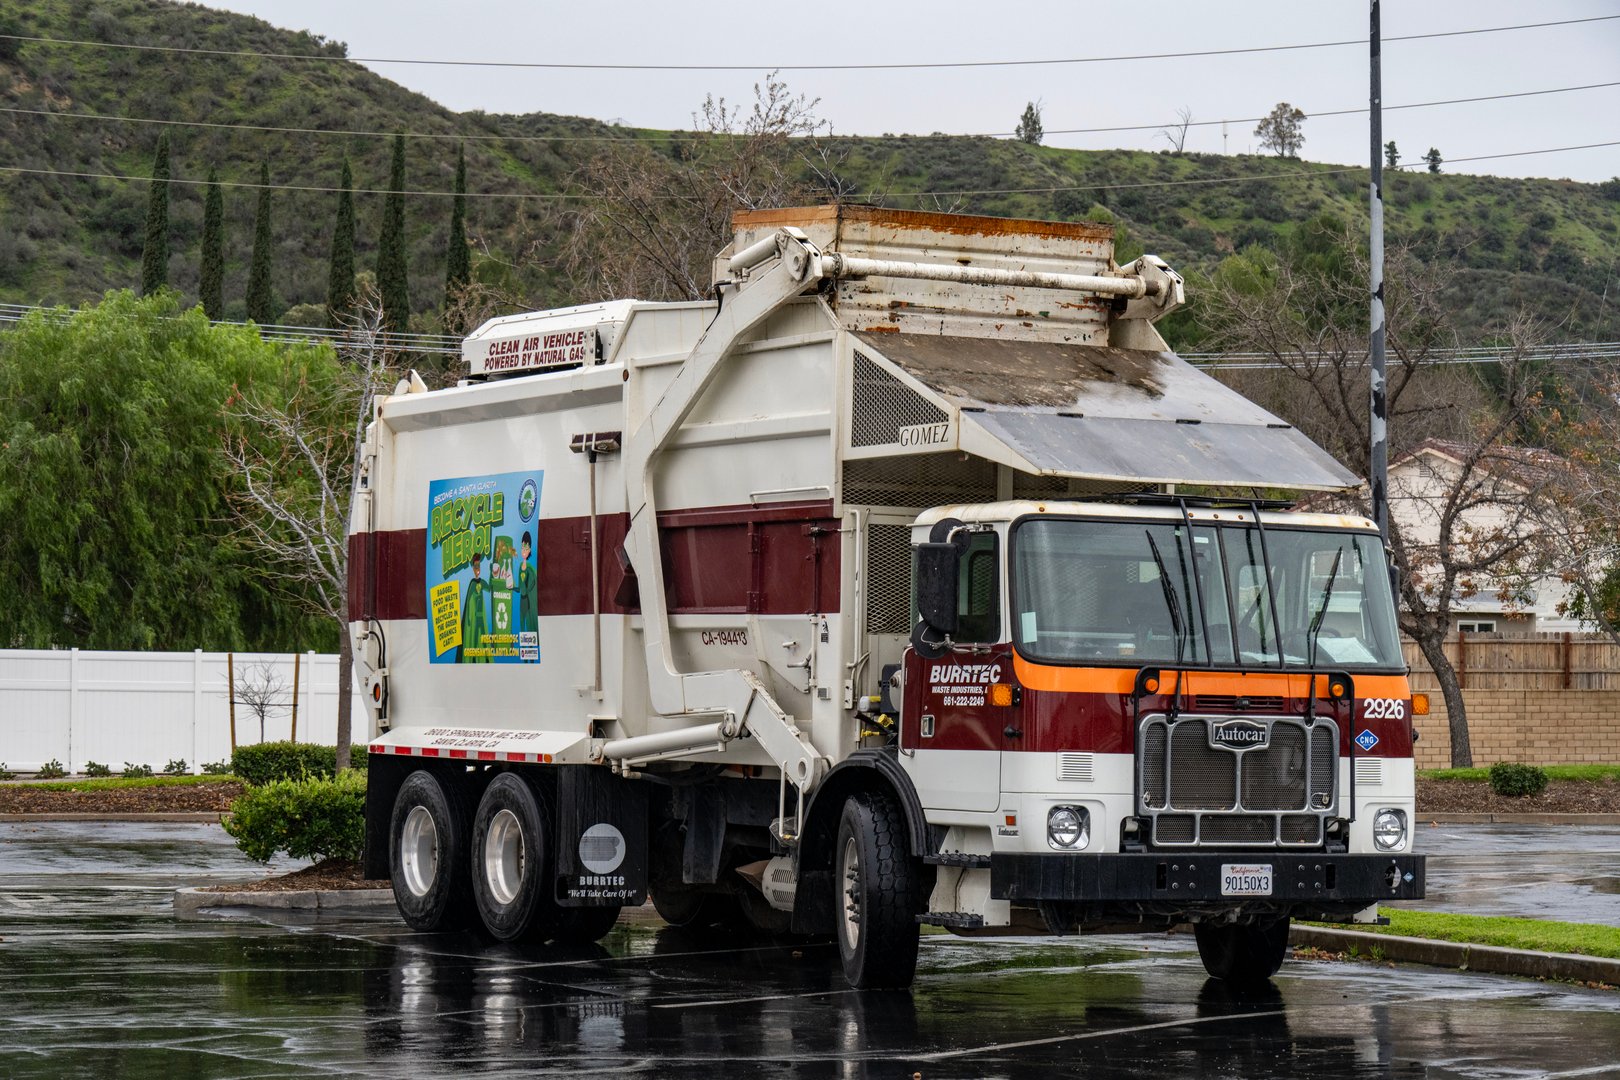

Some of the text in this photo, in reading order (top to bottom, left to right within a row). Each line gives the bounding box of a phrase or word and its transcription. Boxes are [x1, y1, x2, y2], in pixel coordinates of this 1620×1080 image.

[489, 331, 584, 357] CLEAN AIR VEHICLE
[484, 346, 584, 371] POWERED BY NATURAL GAS
[900, 424, 949, 447] GOMEZ
[431, 492, 503, 547] RECYCLE
[442, 524, 491, 577] HERO!
[701, 631, 748, 645] CA-194413
[929, 664, 1001, 683] BURRTEC
[931, 686, 950, 694] WASTE
[951, 686, 984, 696] INDUSTRIES,
[1363, 698, 1405, 719] 2926
[1215, 726, 1266, 742] Autocar
[1359, 736, 1374, 744] CNG
[1231, 866, 1260, 876] California
[579, 876, 625, 886] BURRTEC
[1225, 876, 1269, 891] 90150X3
[587, 889, 602, 898] Take
[602, 889, 617, 898] Care
[618, 889, 627, 899] Of
